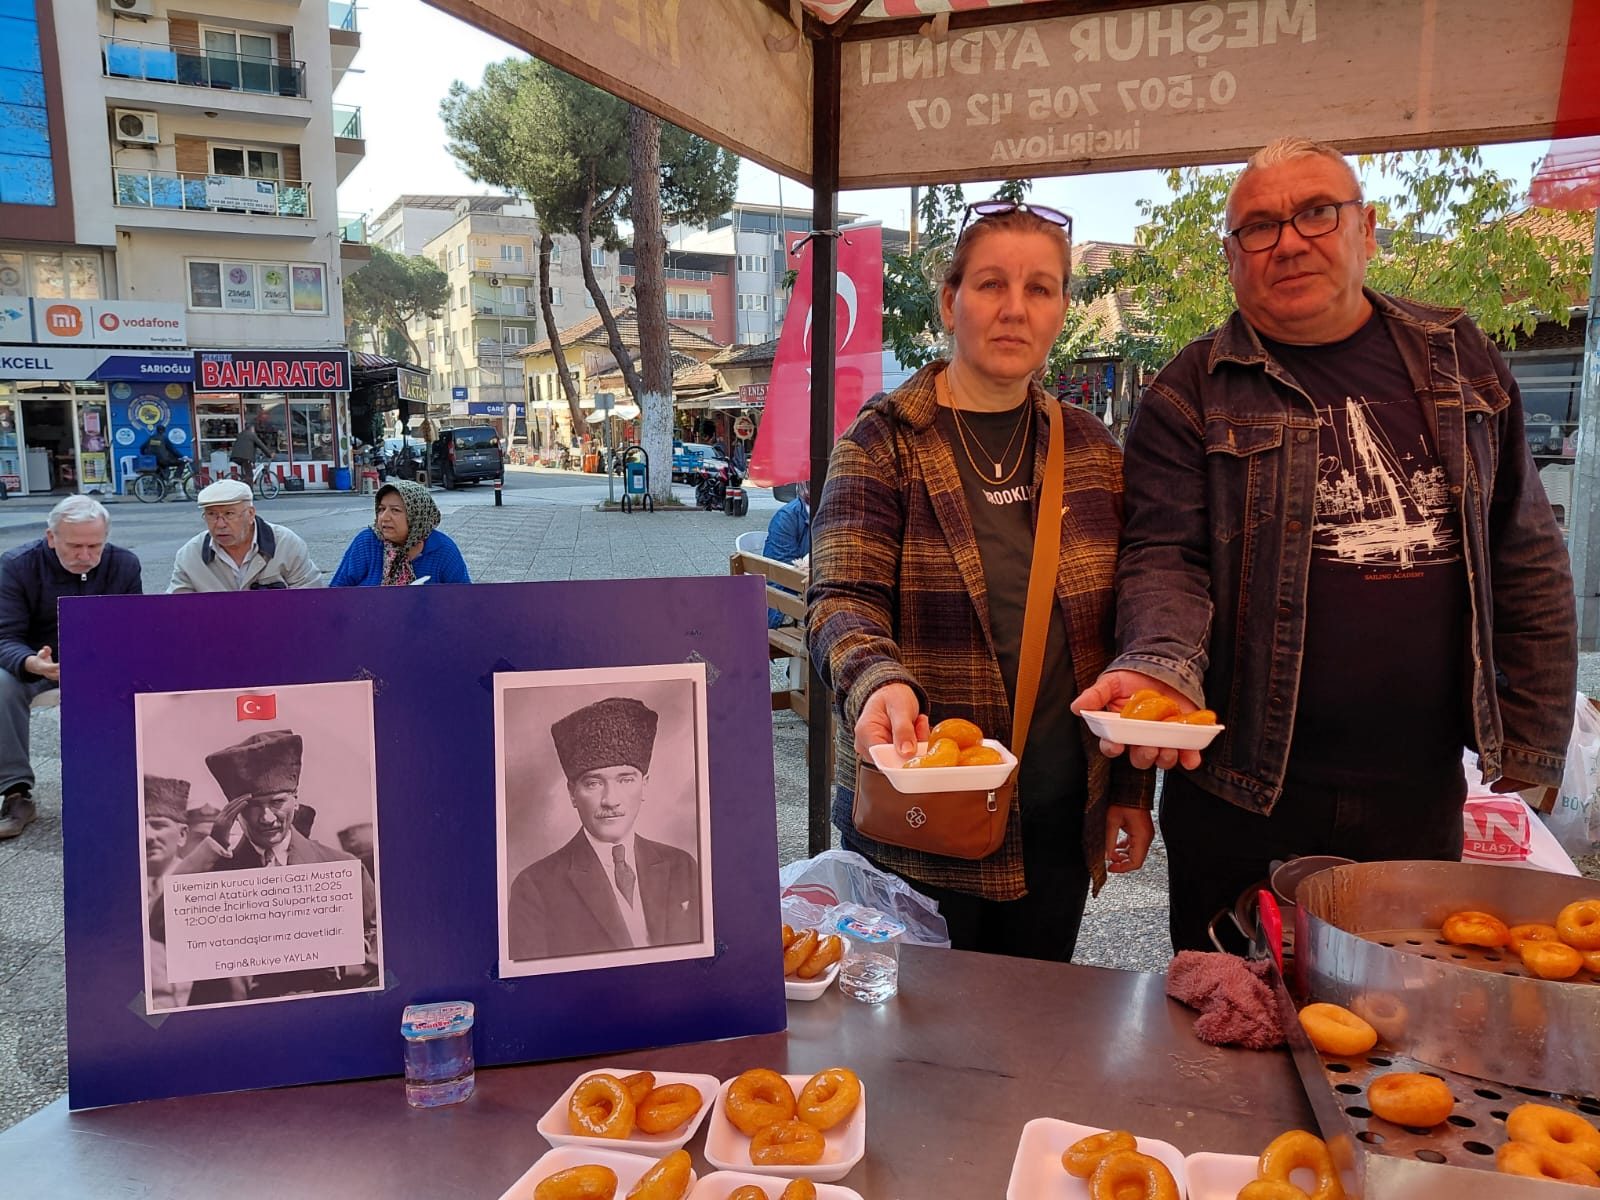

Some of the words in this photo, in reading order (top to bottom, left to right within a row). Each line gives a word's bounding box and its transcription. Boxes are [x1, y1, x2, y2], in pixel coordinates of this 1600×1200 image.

[123, 317, 179, 329] vodafone
[0, 357, 54, 370] KCELL
[140, 363, 191, 374] SARIOĞLU
[202, 360, 343, 388] BAHARATCI
[1473, 842, 1514, 854] PLAST
[172, 881, 219, 893] Ülkemizin
[221, 879, 255, 888] kurucu
[256, 875, 283, 885] lideri
[284, 873, 309, 883] Gazi
[310, 868, 353, 881] Mustafa
[184, 892, 217, 903] Kemal
[219, 888, 258, 900] Atatürk
[260, 886, 290, 897] adına
[292, 880, 342, 894] 13.11.2025
[174, 904, 221, 916] tarihinde
[272, 895, 328, 908] Suluparkta
[329, 892, 353, 902] saat
[235, 911, 266, 922] lokma
[187, 939, 207, 950] Tüm
[209, 933, 291, 947] vatandaşlarımız
[293, 927, 345, 939] davetlidir.
[283, 952, 319, 963] YAYLAN
